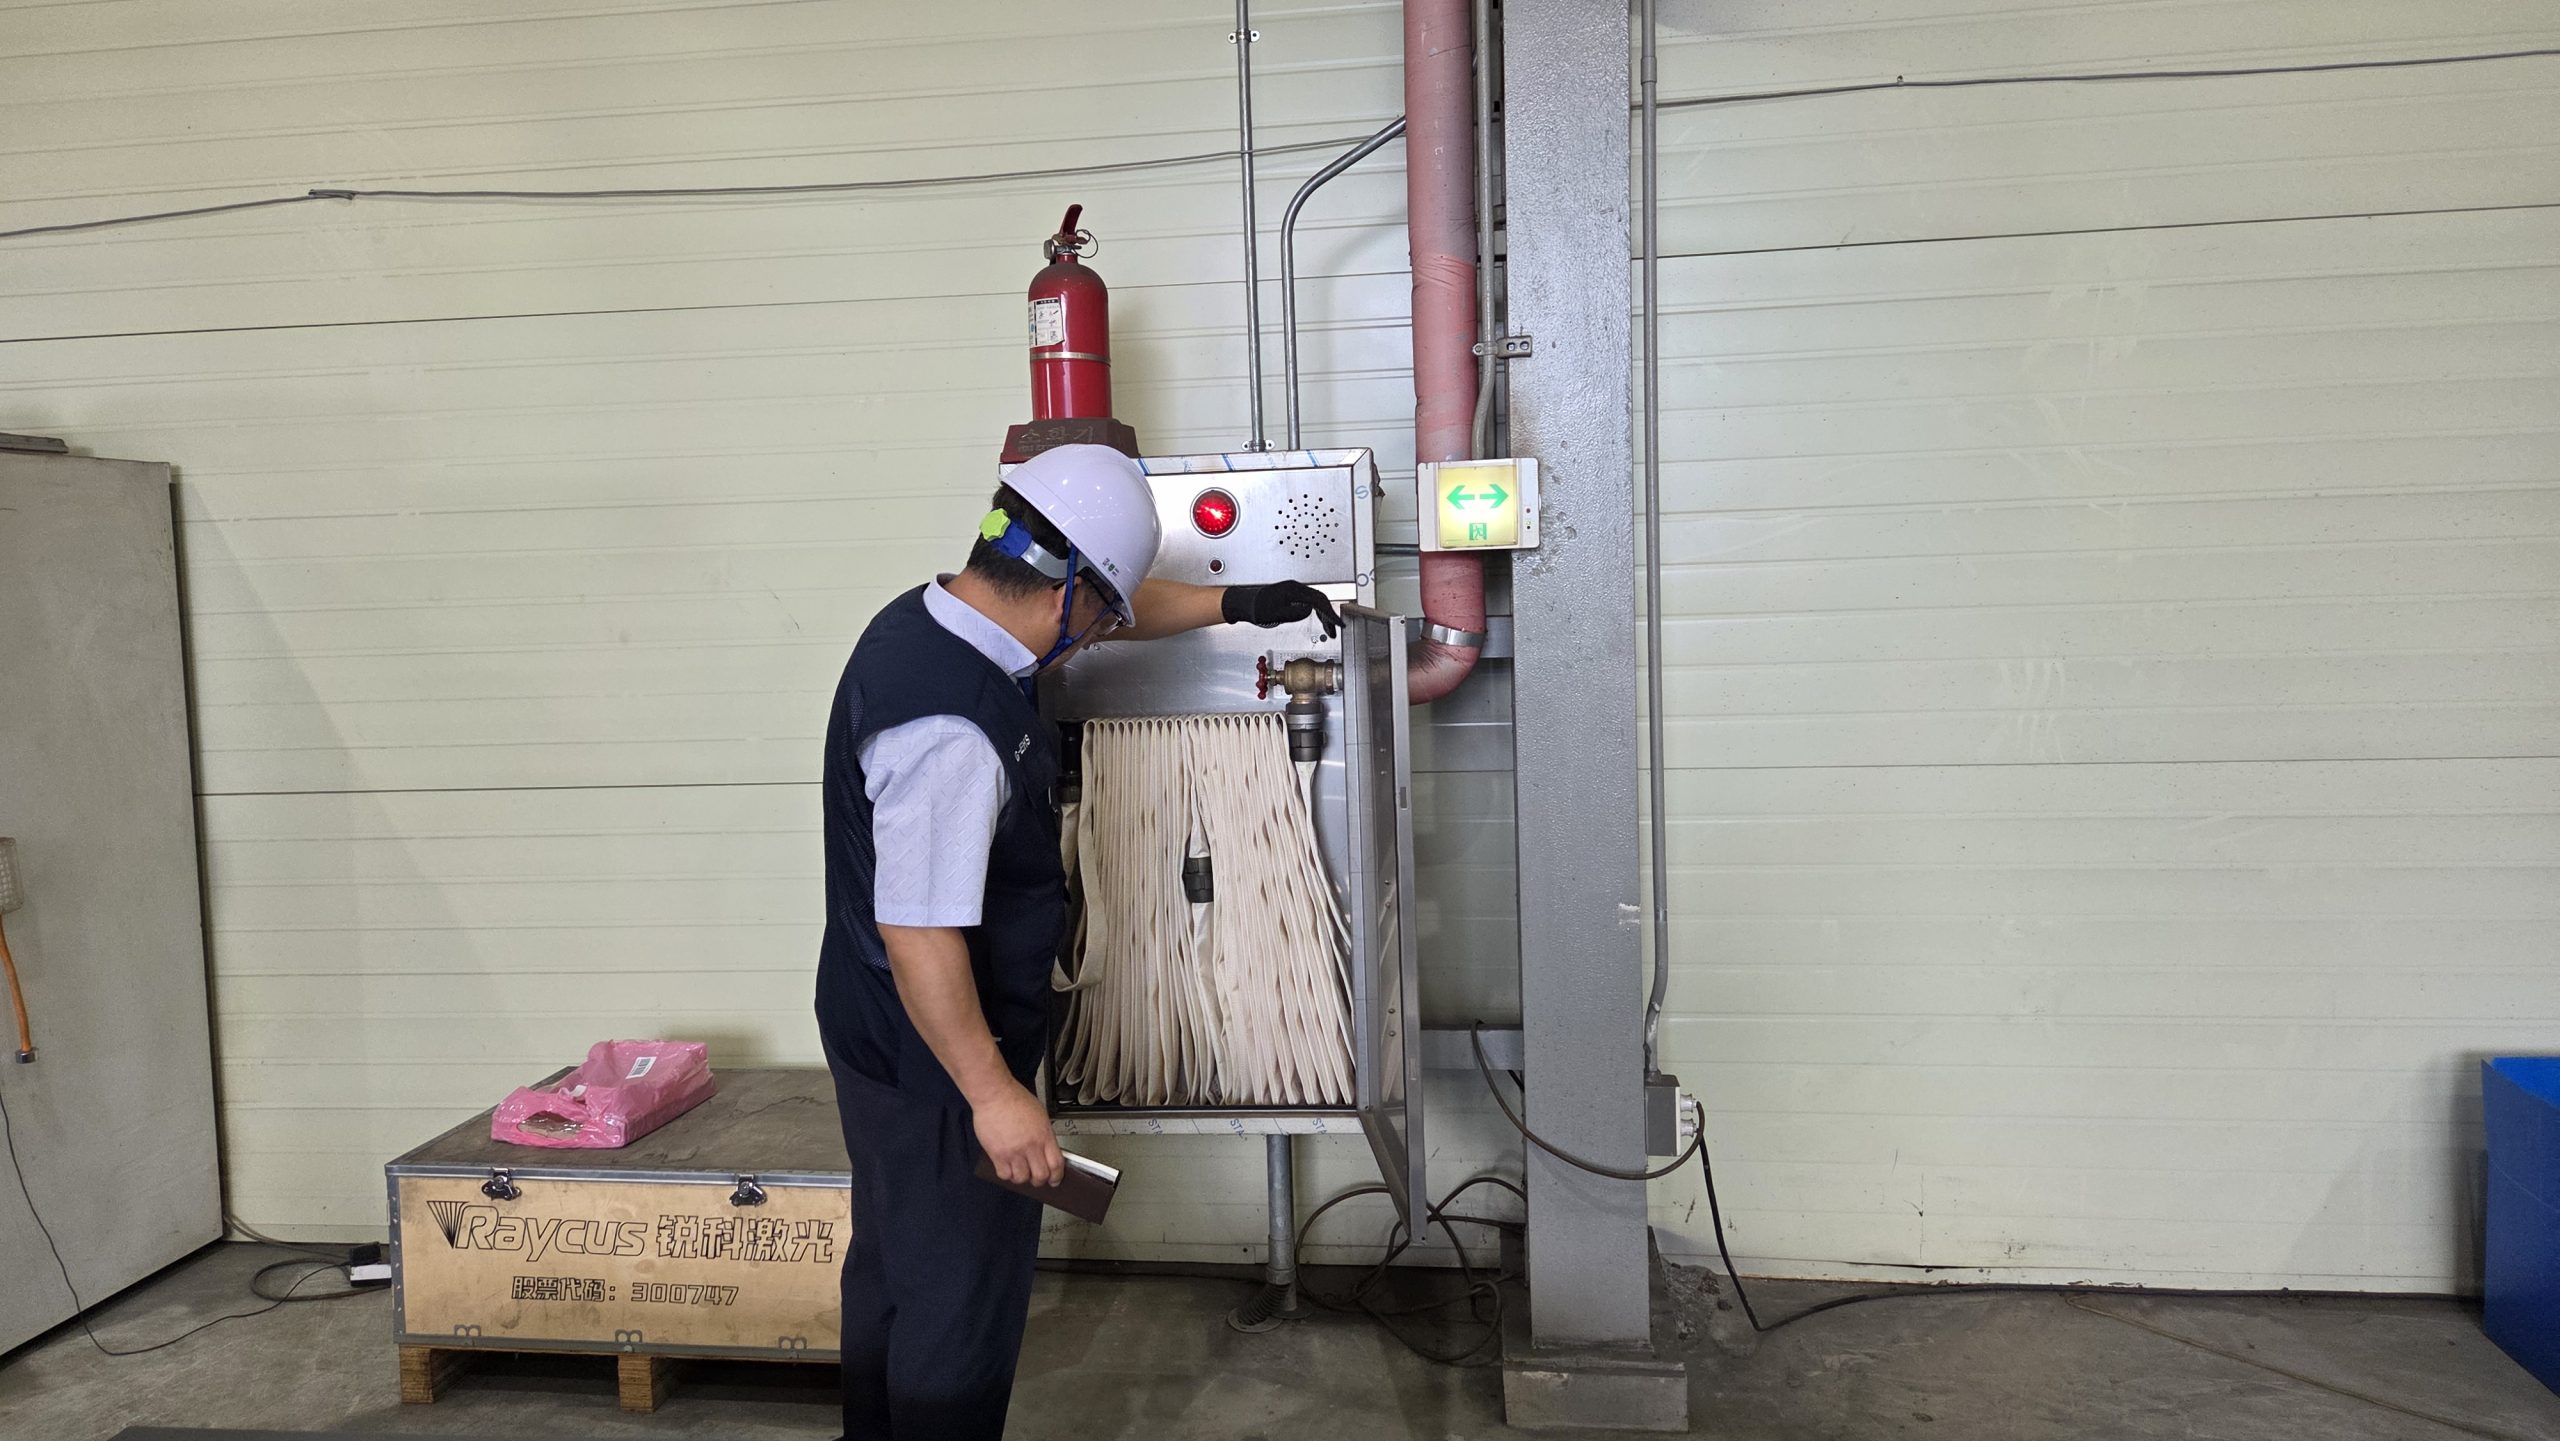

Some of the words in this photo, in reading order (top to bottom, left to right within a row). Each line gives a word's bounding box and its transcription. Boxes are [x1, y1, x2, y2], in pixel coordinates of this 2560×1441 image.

[454, 1204, 649, 1263] Raycus
[656, 1214, 834, 1263] 锐科激光
[631, 1281, 740, 1306] 300747
